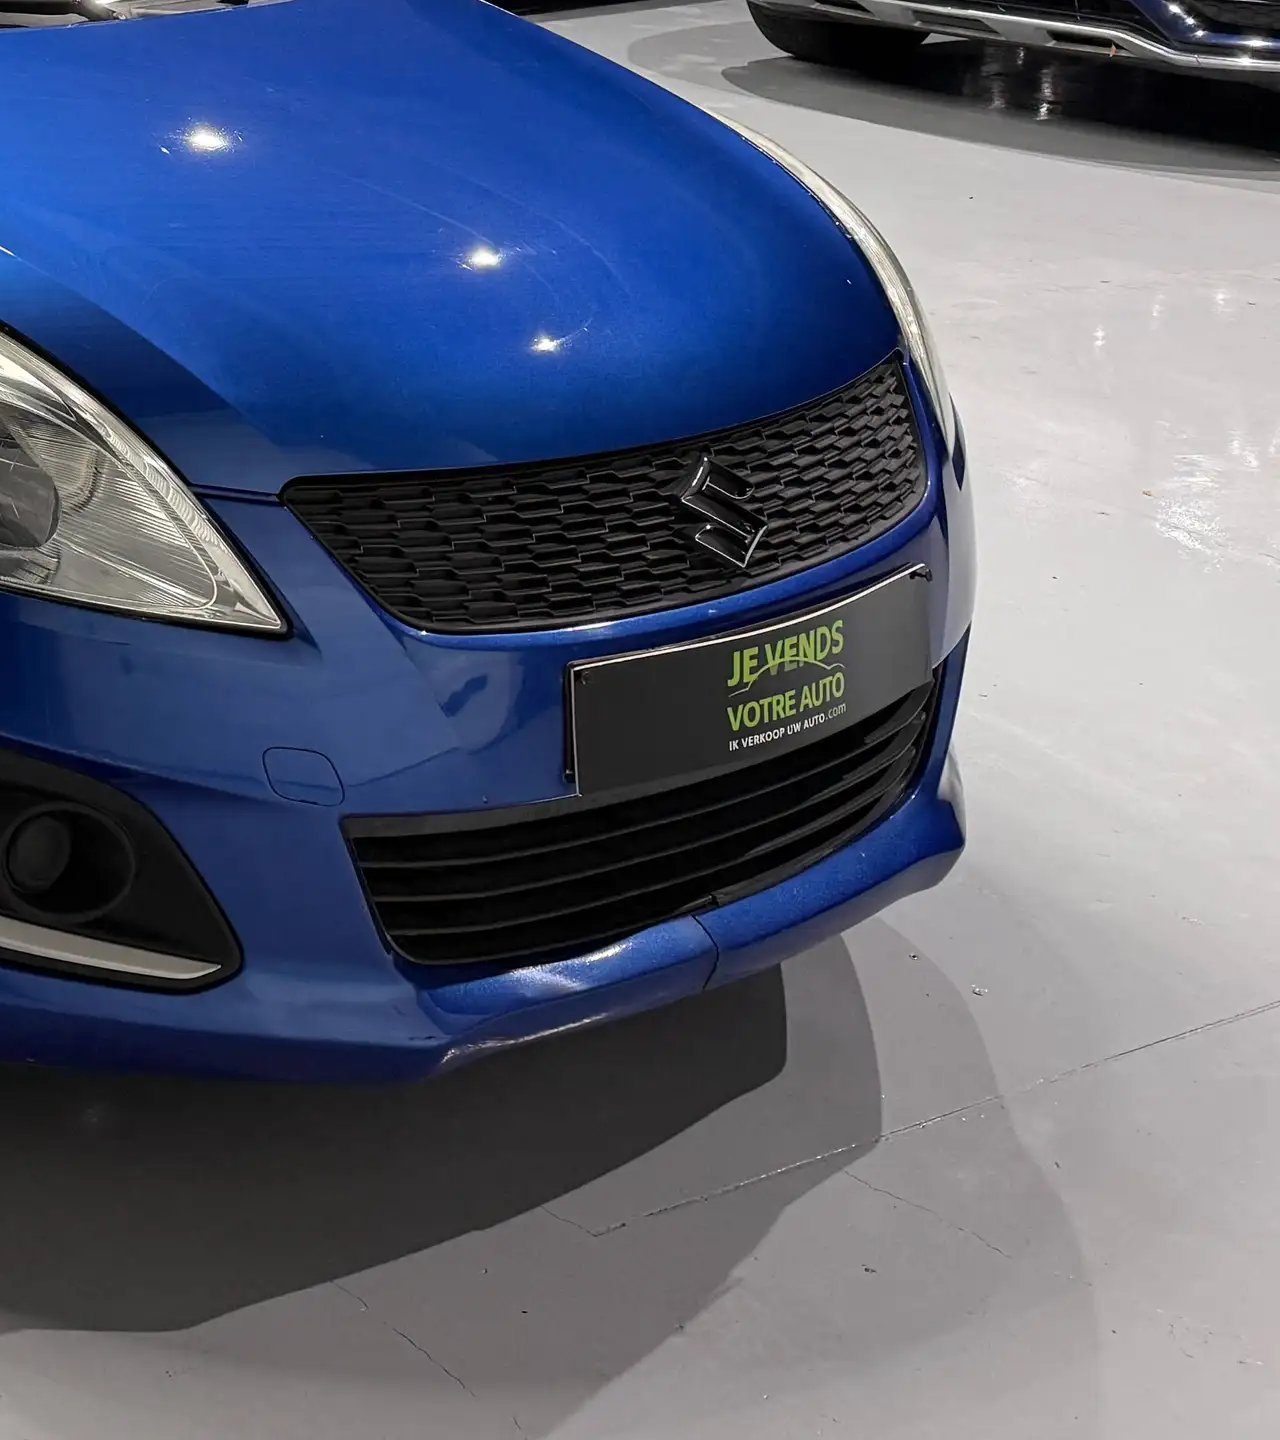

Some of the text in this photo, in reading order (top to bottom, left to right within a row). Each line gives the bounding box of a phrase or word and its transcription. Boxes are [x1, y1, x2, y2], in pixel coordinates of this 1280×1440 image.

[727, 619, 844, 687] JE VENDS
[726, 671, 845, 731] VOTRE AUTO
[729, 739, 739, 751] IK
[741, 727, 786, 748] VERKOOP
[787, 722, 801, 735] UW
